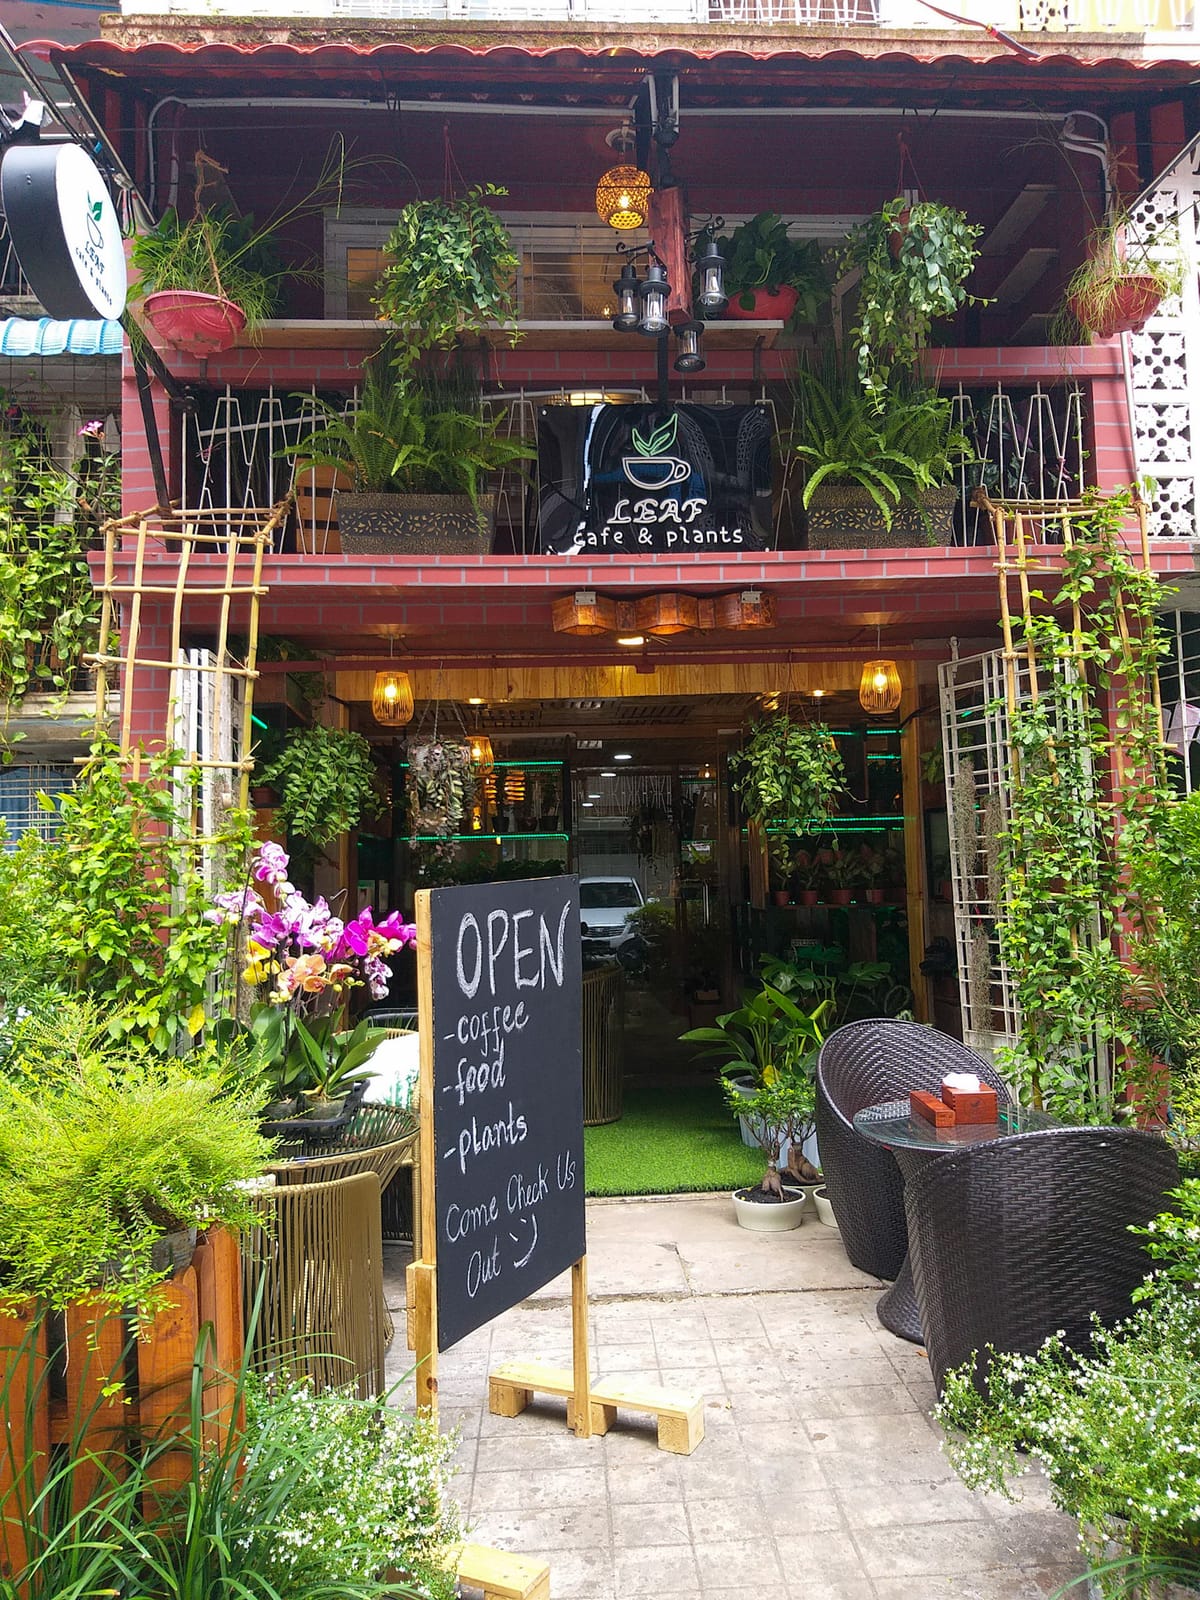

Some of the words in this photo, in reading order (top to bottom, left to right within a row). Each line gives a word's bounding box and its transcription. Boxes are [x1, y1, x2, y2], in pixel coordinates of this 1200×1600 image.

[573, 526, 624, 545] cafe
[638, 528, 653, 545] &
[666, 526, 744, 547] plants
[607, 498, 707, 524] LEAF
[456, 900, 571, 999] OPEN
[446, 1196, 499, 1243] Come
[507, 1163, 549, 1213] Check
[557, 1150, 576, 1190] Us
[467, 1235, 501, 1298] Out
